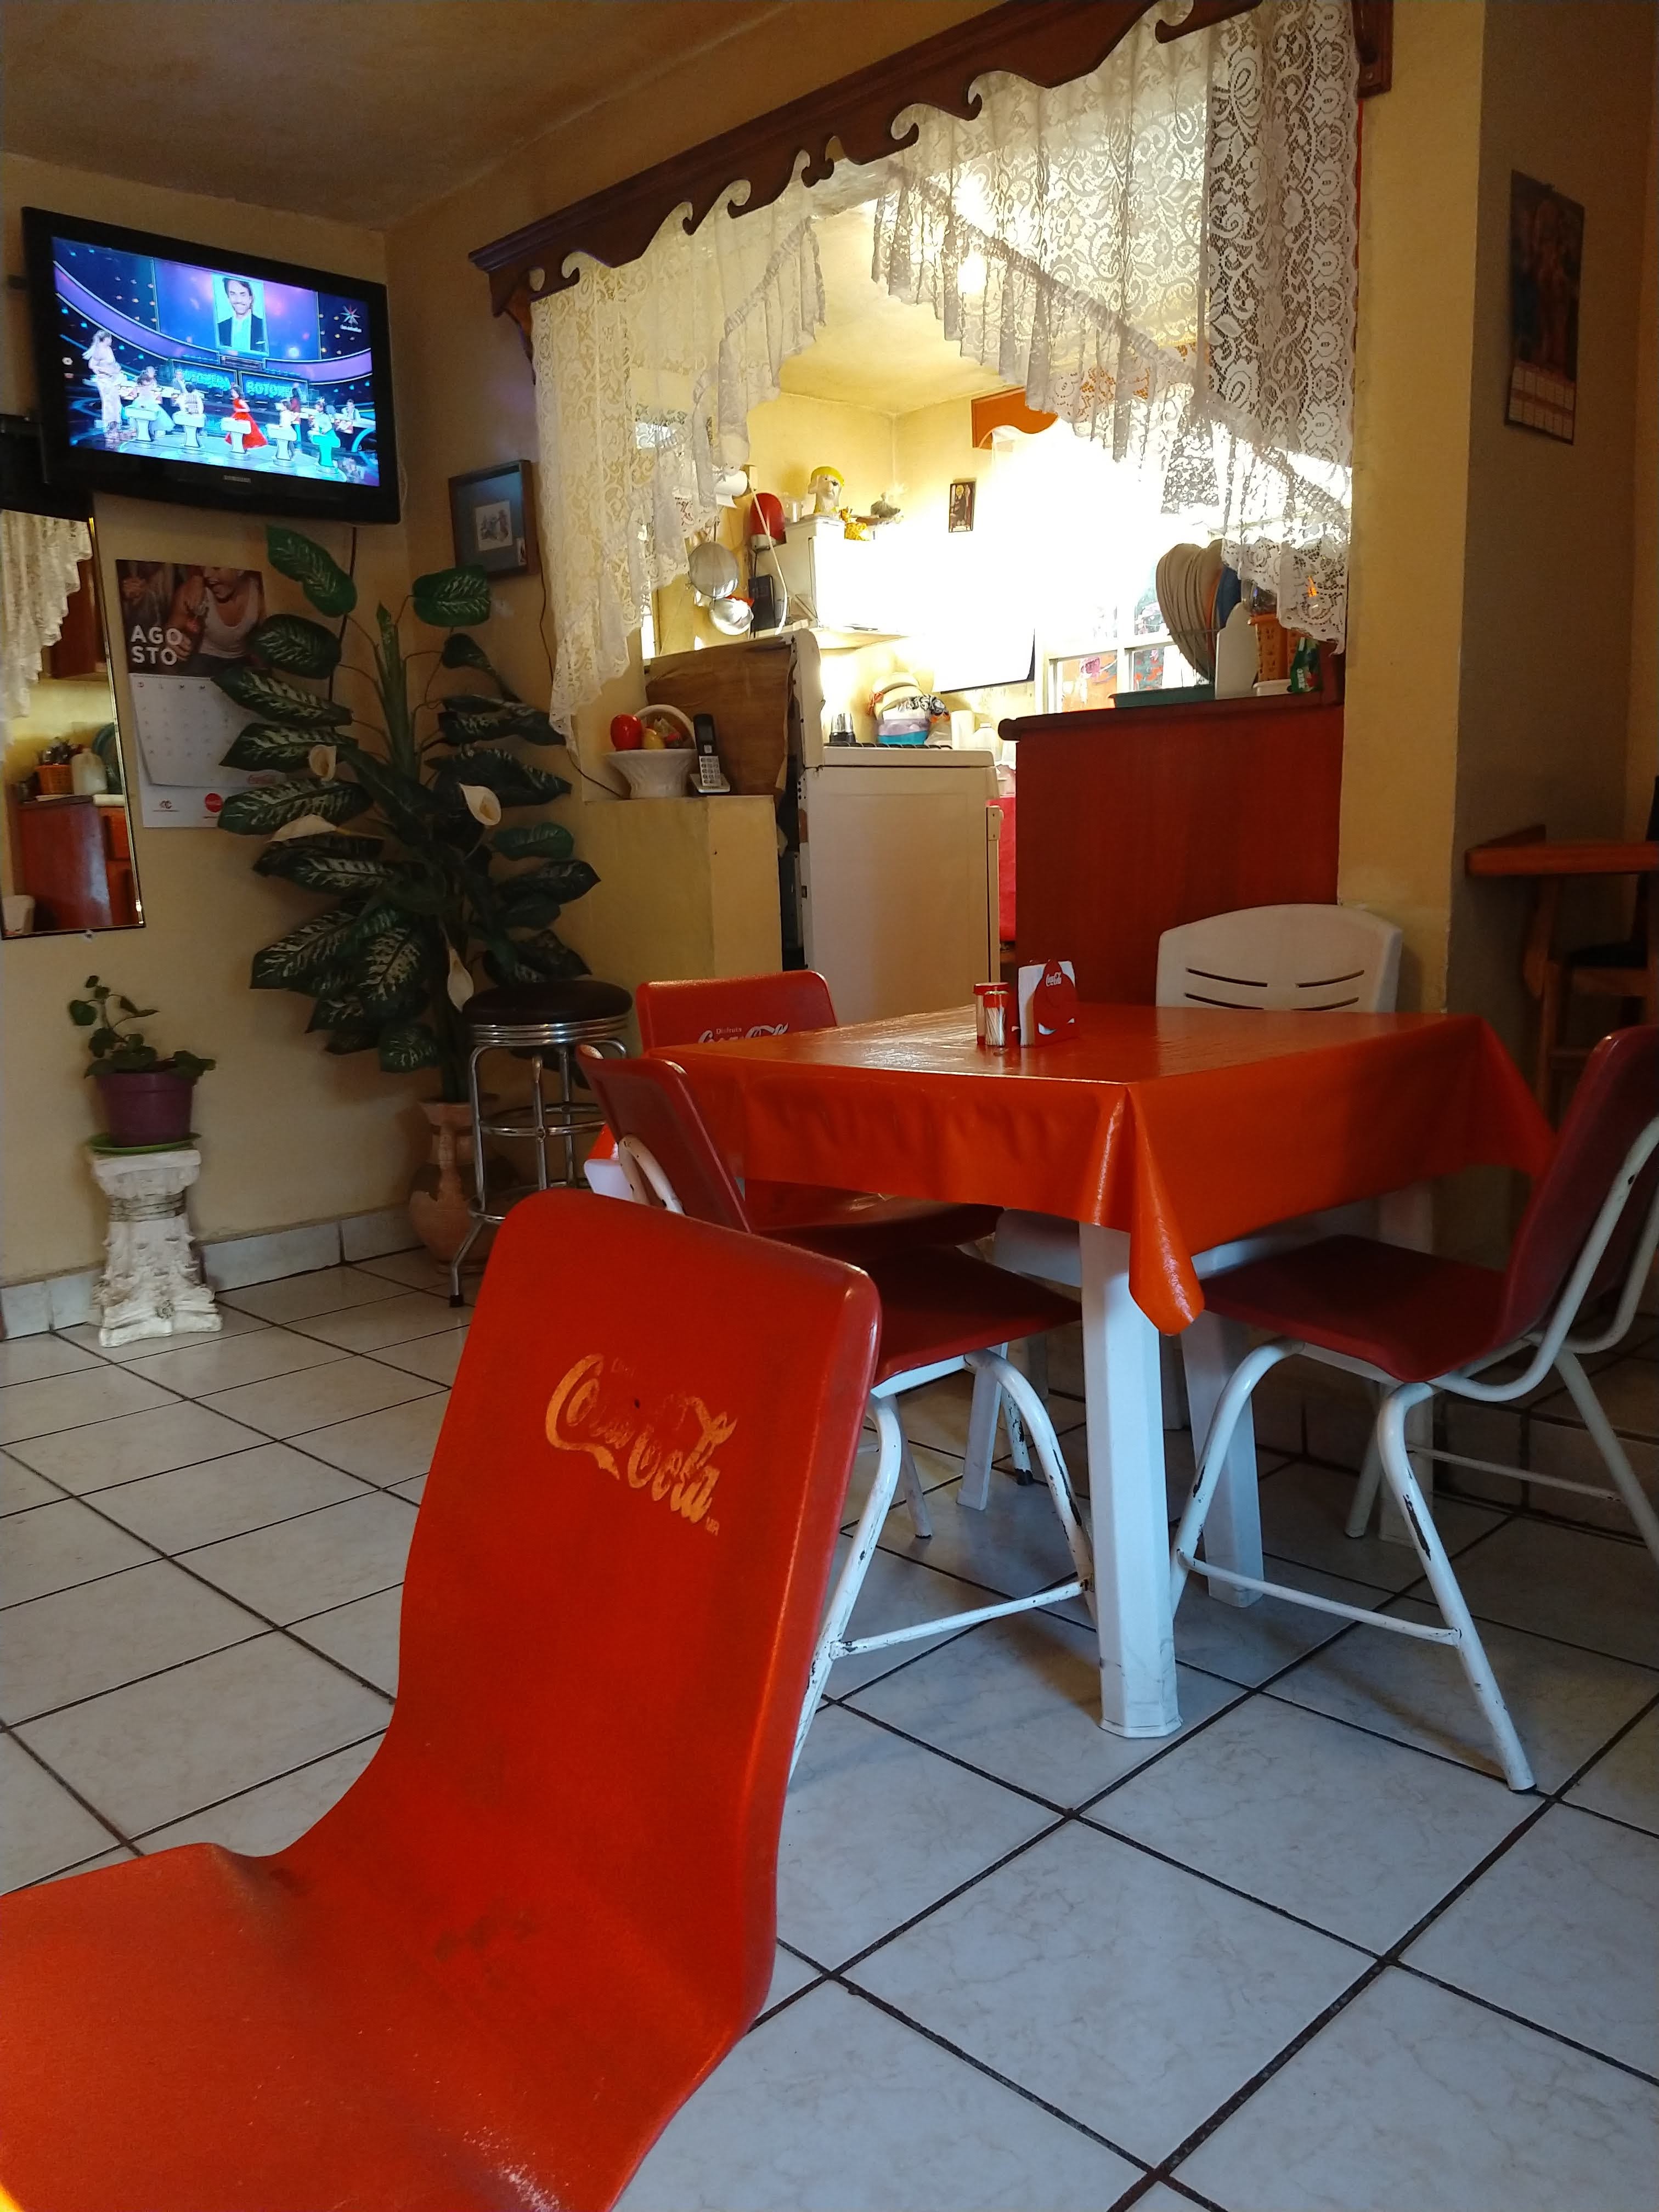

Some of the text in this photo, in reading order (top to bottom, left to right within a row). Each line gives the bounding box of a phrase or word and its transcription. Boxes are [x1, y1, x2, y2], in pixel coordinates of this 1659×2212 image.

[130, 624, 183, 645] AGO
[132, 646, 178, 665] STO
[1046, 972, 1062, 986] Coca-Cola
